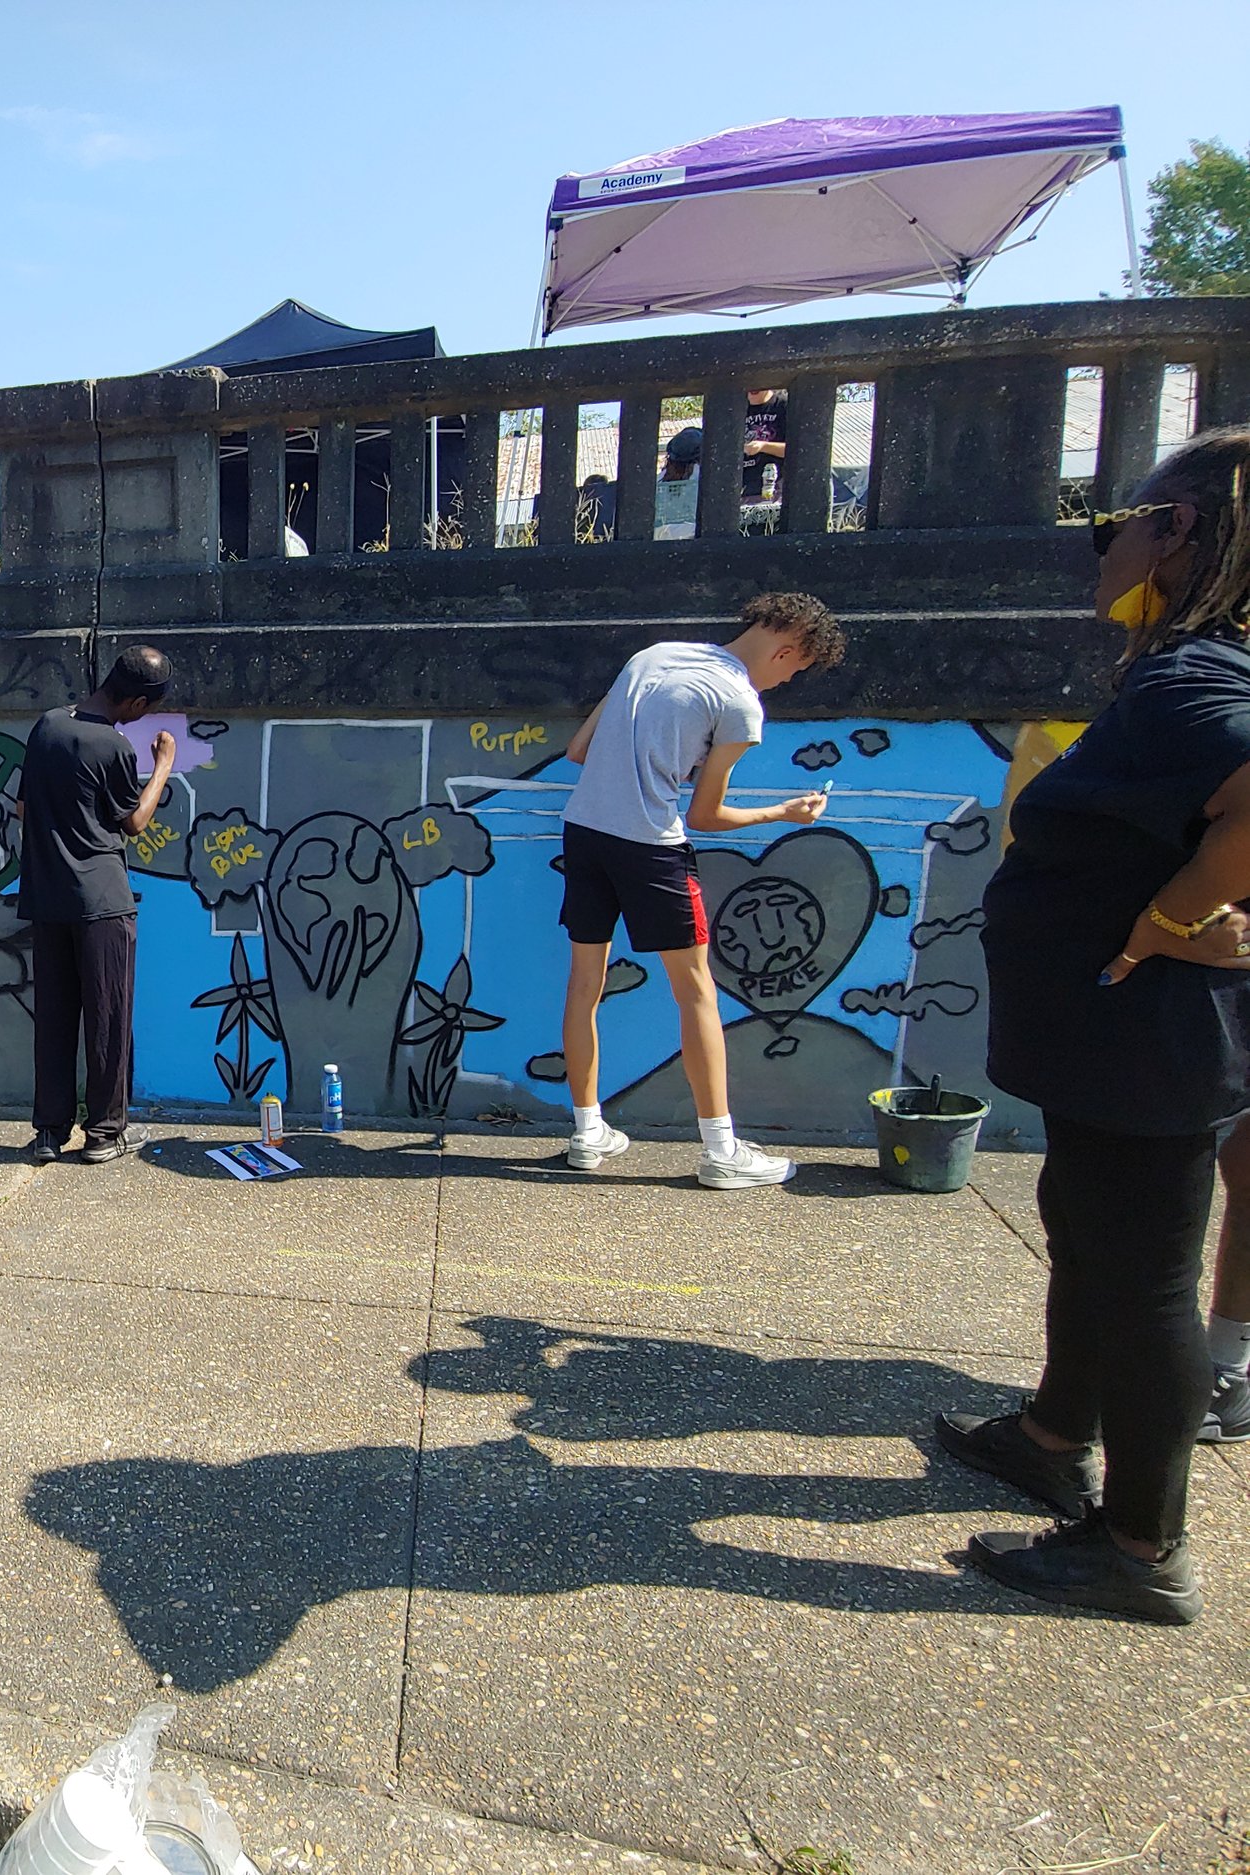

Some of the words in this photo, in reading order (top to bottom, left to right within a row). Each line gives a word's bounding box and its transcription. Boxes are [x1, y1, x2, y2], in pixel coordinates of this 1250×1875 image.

[601, 173, 663, 191] Academy
[470, 722, 549, 755] Purple
[137, 825, 181, 865] Blue
[403, 817, 442, 850] LB
[210, 843, 263, 879] Blue
[738, 960, 825, 1000] PEACE
